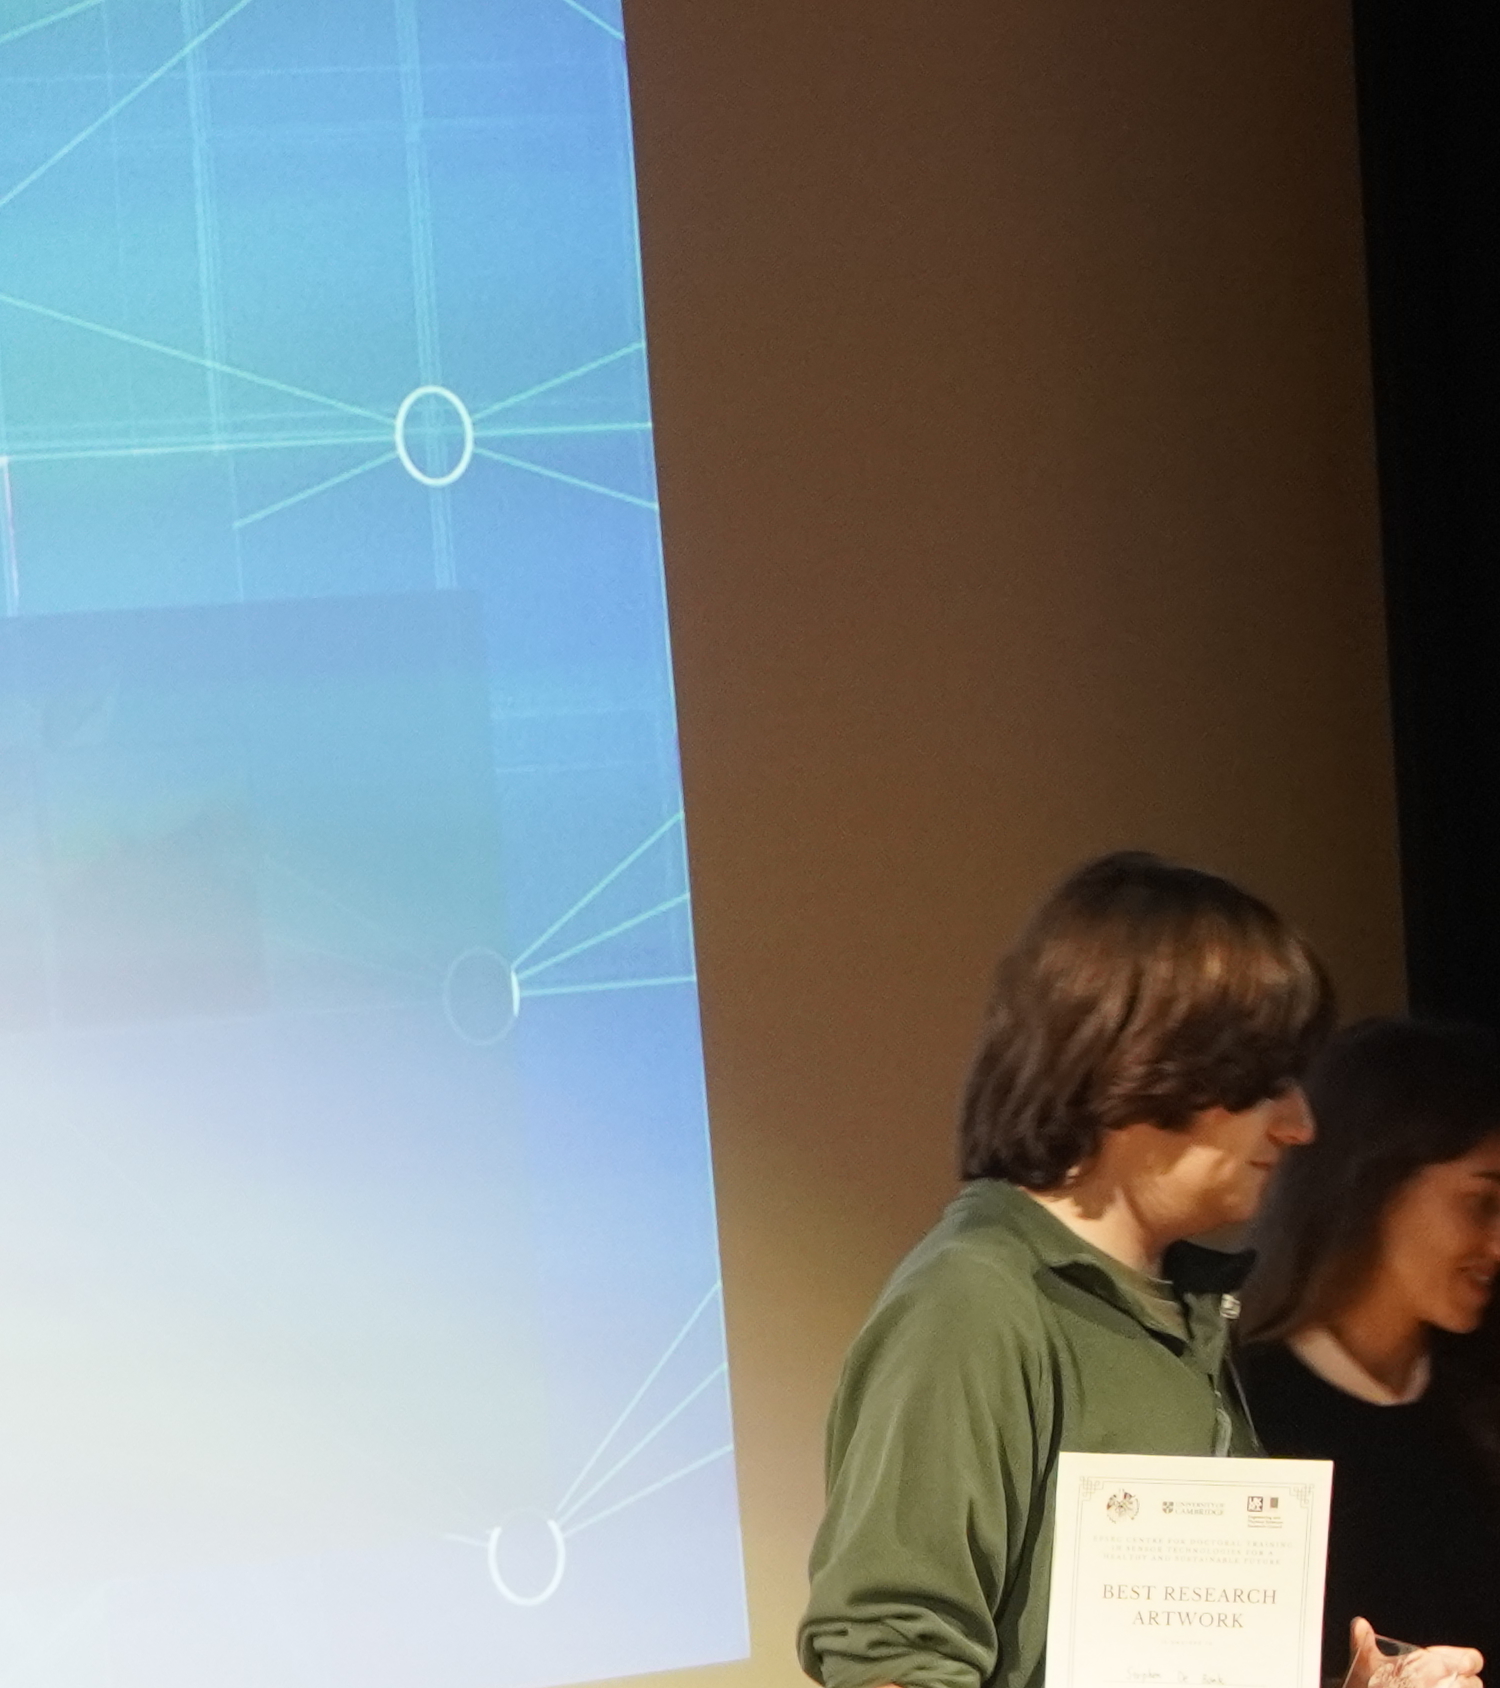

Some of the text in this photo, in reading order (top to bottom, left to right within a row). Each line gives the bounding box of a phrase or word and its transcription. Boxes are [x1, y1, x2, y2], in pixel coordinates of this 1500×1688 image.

[1103, 1584, 1277, 1605] BEST RESEARCH
[1132, 1610, 1244, 1629] ARTWORK
